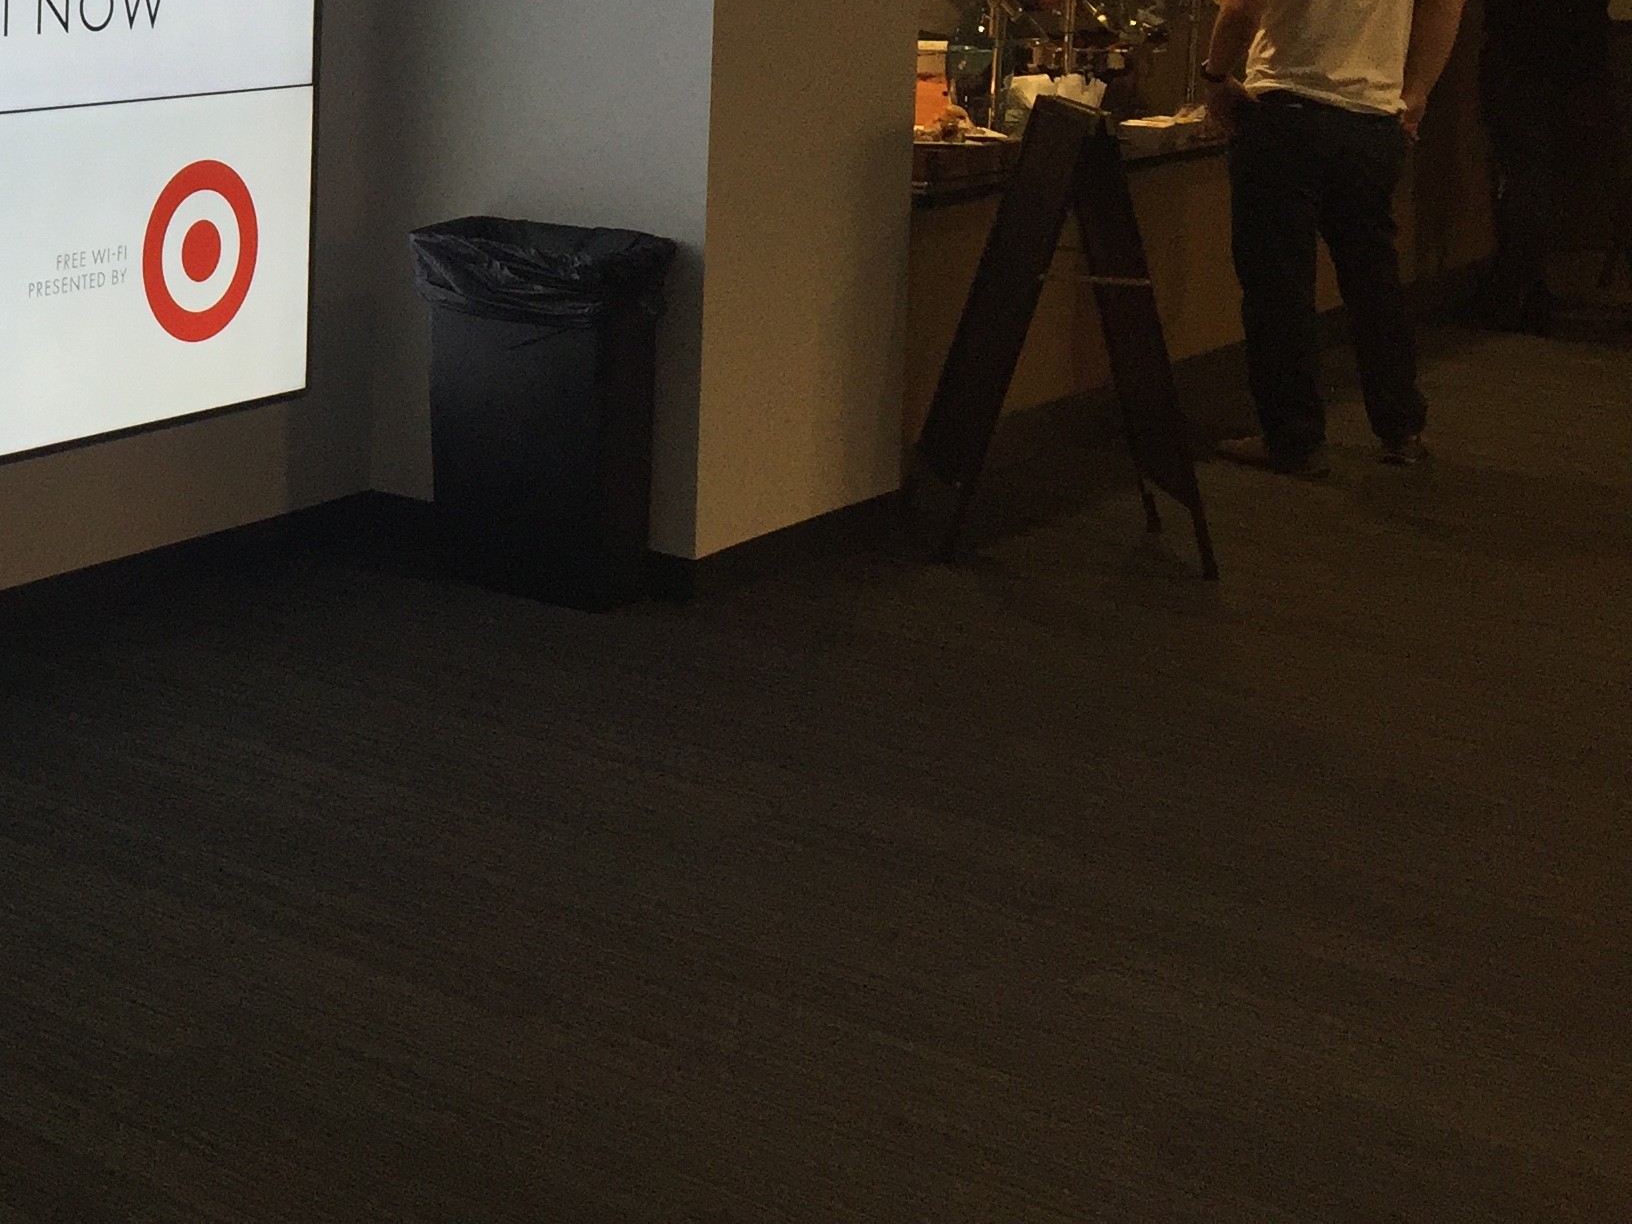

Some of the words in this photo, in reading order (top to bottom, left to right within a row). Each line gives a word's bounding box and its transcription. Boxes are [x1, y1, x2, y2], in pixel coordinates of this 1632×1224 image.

[56, 251, 86, 271] FREE
[91, 245, 128, 264] WI-FI
[28, 271, 106, 298] PRESENTED
[111, 268, 128, 285] BY
